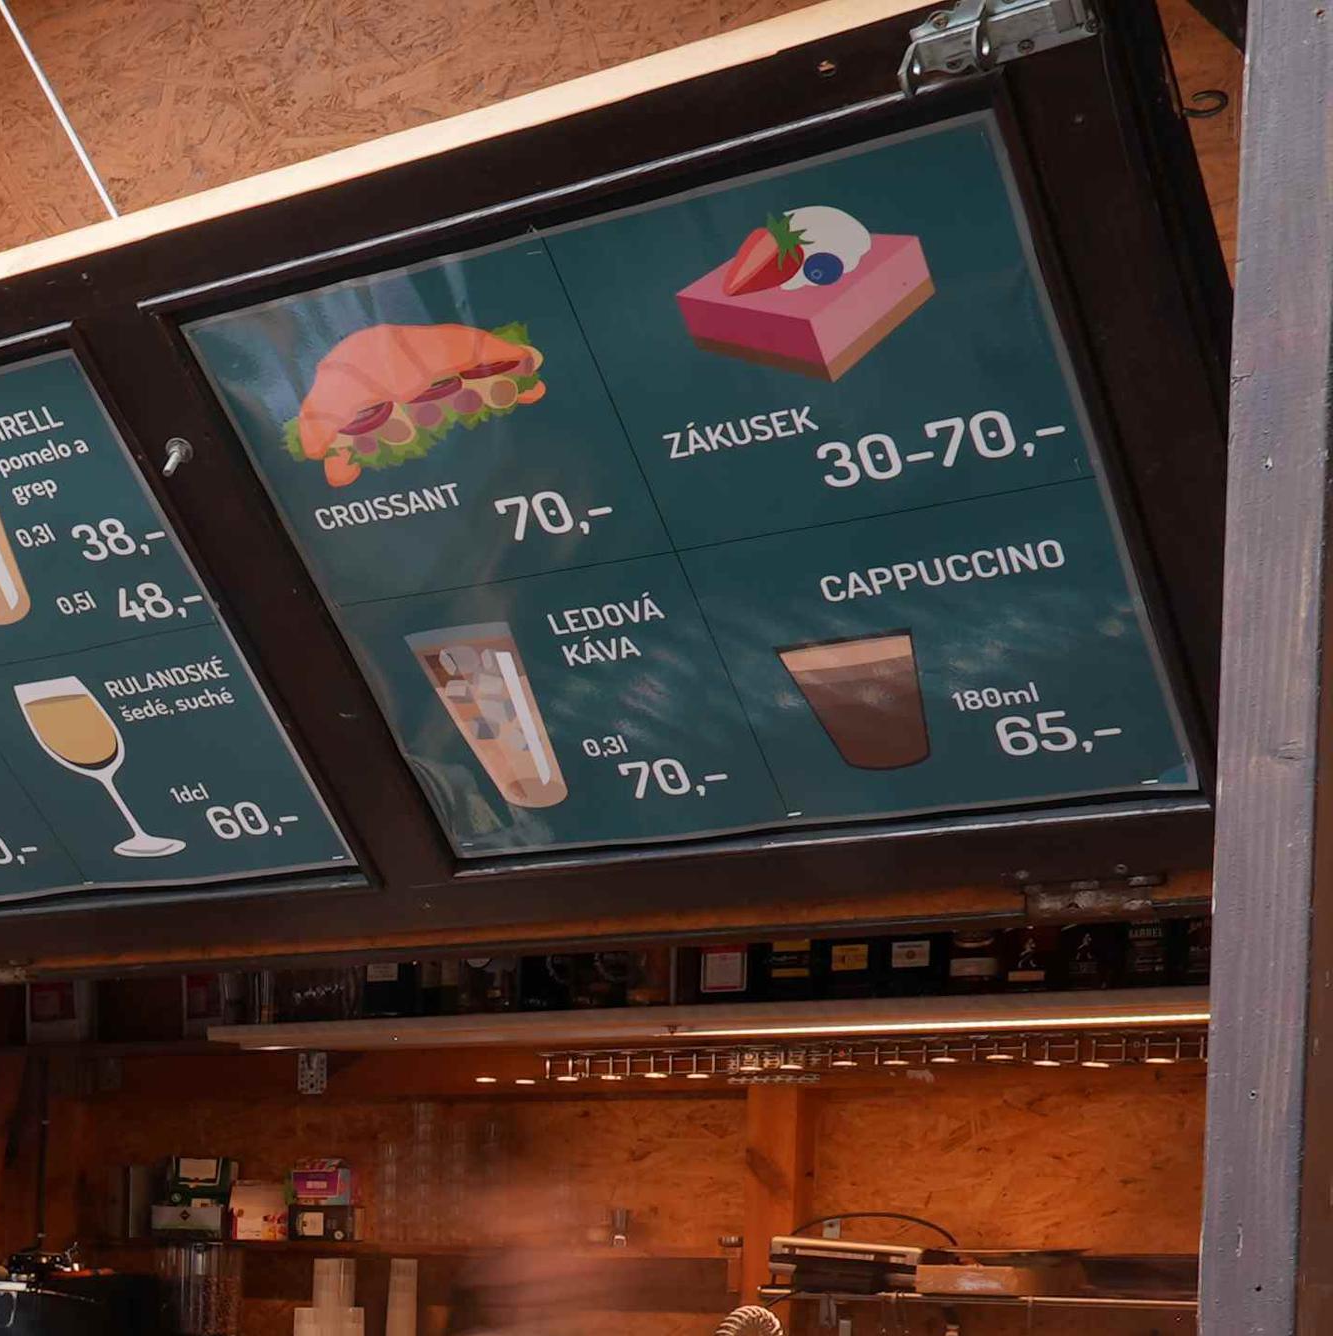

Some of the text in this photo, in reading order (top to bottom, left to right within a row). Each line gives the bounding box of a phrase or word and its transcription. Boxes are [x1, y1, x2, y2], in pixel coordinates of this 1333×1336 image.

[74, 438, 90, 456] a
[662, 405, 820, 461] ZÁKUSEK
[12, 477, 58, 507] grep
[314, 481, 462, 533] CROISSANT
[495, 490, 613, 543] 70,-
[71, 517, 165, 562] 38,-
[819, 538, 1066, 604] CAPPUCCINO
[116, 581, 204, 623] 48,-
[546, 592, 665, 638] LEDOVÁ
[562, 631, 641, 669] KÁVA
[104, 656, 230, 699] RULANDSKÉ
[952, 682, 1040, 714] 180ml
[121, 686, 234, 724] šedé, suché
[993, 710, 1122, 758] 65,-
[618, 758, 728, 800] 70,-
[206, 801, 299, 841] 60,-
